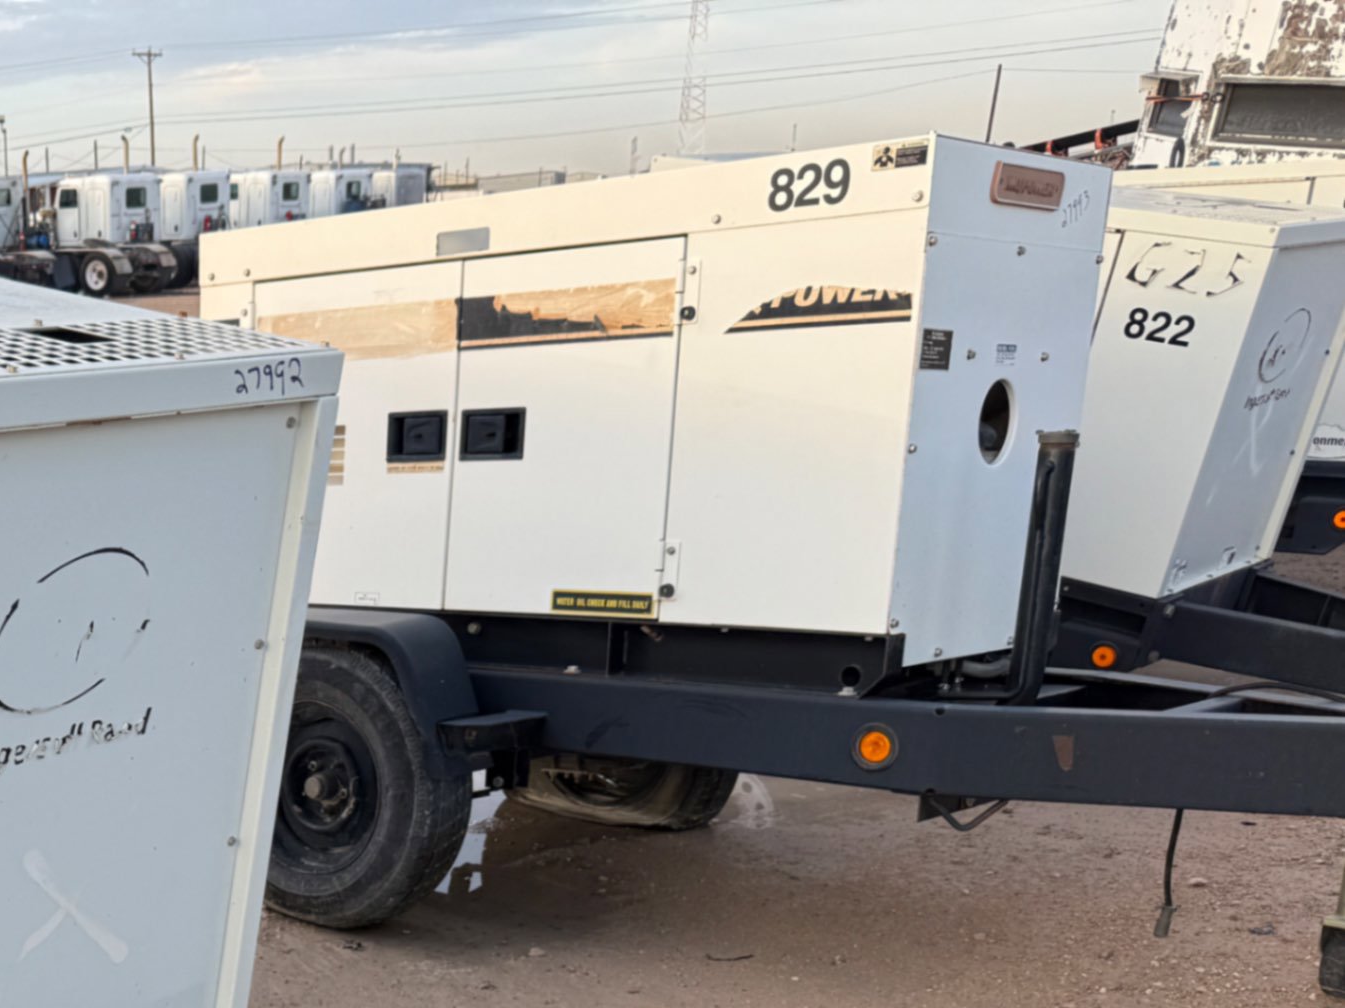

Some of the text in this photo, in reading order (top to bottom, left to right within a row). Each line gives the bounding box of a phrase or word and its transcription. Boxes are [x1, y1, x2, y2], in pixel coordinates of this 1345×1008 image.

[768, 158, 851, 212] 829
[1123, 307, 1196, 347] 822
[234, 357, 305, 396] 27992
[90, 706, 153, 745] Rad
